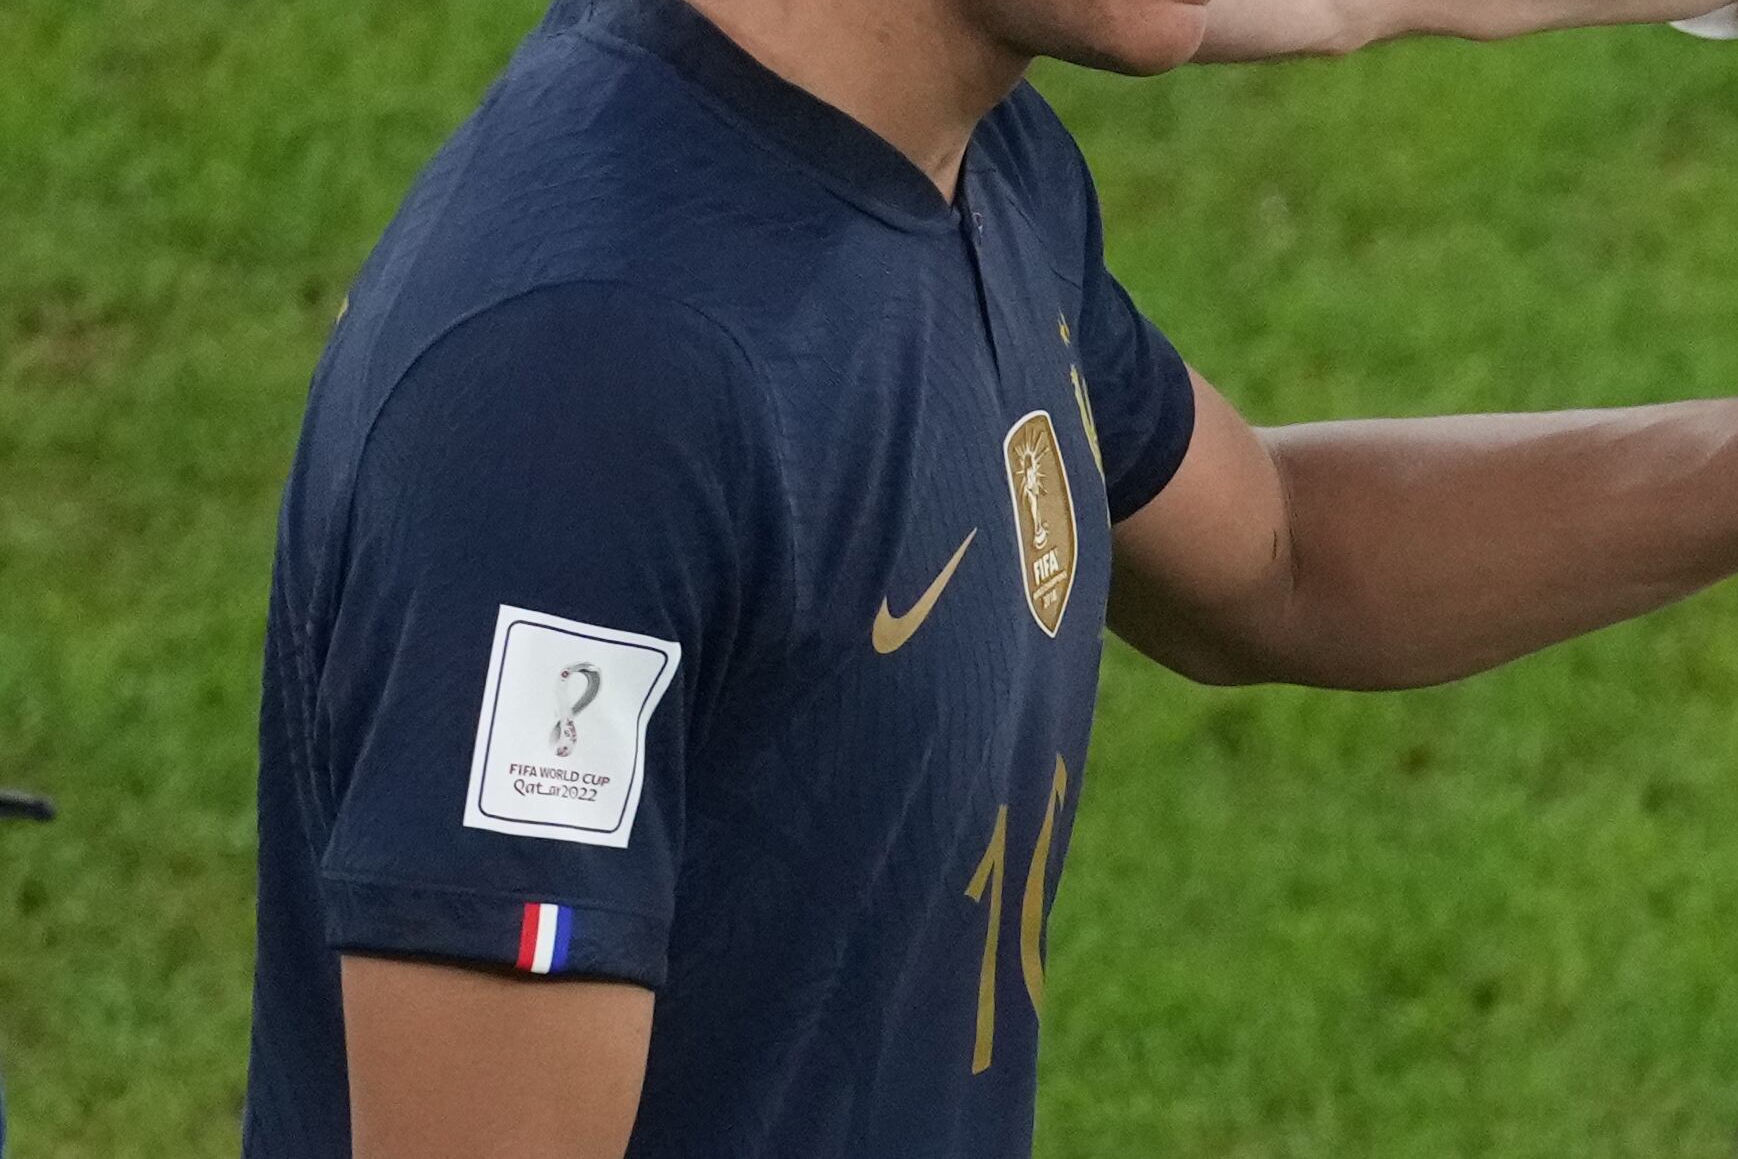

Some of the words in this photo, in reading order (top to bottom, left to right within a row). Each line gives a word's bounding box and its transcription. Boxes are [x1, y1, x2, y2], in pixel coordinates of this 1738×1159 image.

[1033, 548, 1060, 586] FIFA
[509, 763, 537, 778] FIFA
[539, 767, 580, 782] WORLD
[582, 773, 610, 787] CUP
